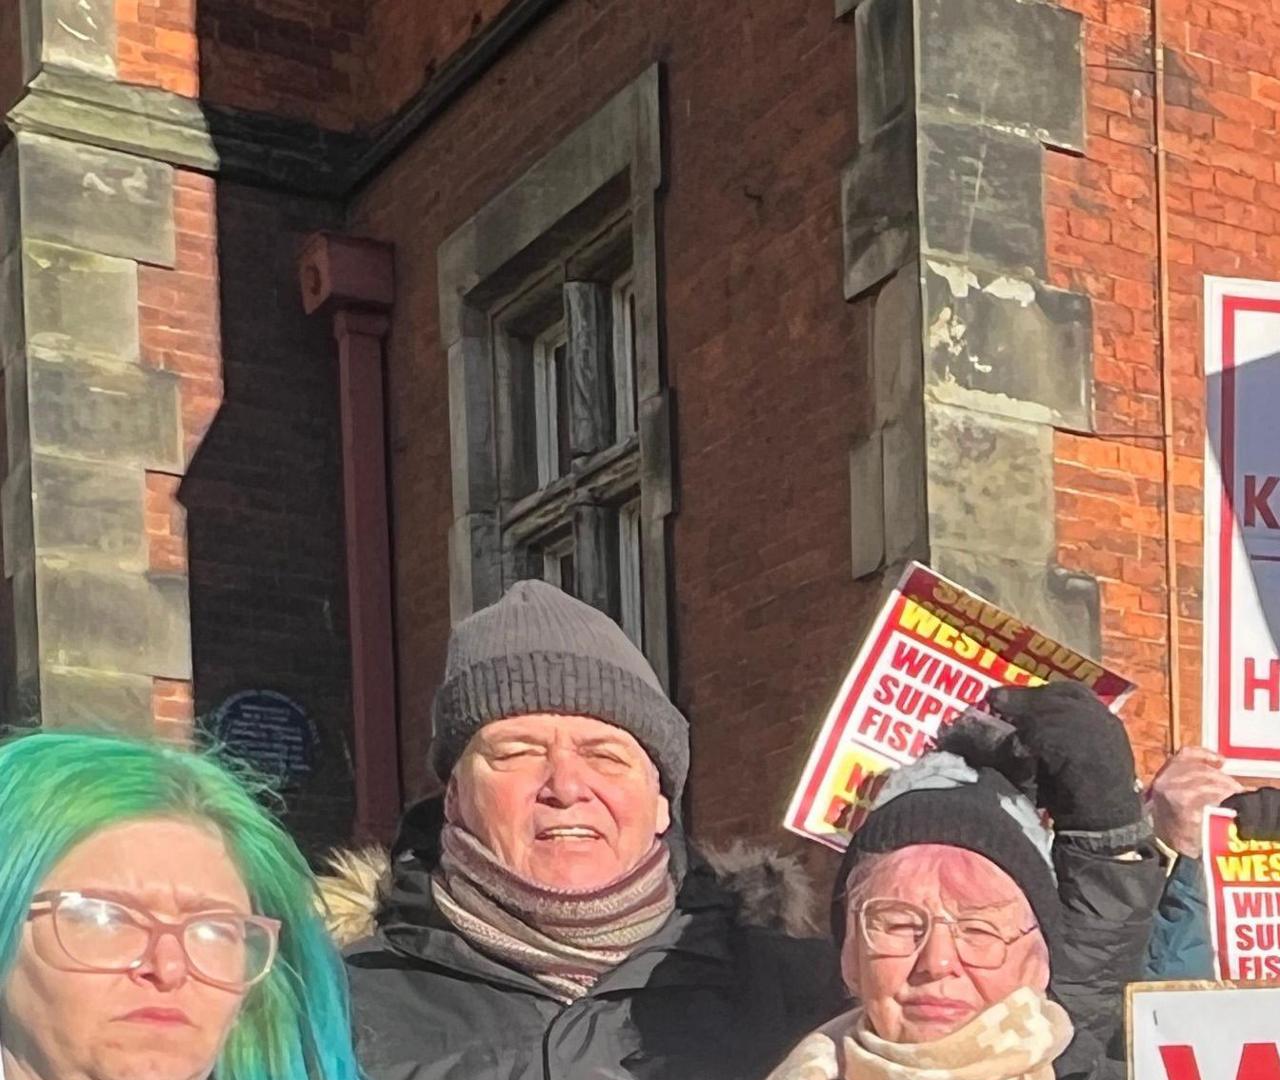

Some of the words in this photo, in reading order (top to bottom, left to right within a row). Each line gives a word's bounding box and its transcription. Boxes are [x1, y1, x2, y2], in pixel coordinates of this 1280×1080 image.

[901, 594, 1009, 669] WEST
[933, 581, 1024, 639] SAVE
[1027, 630, 1103, 685] OUR
